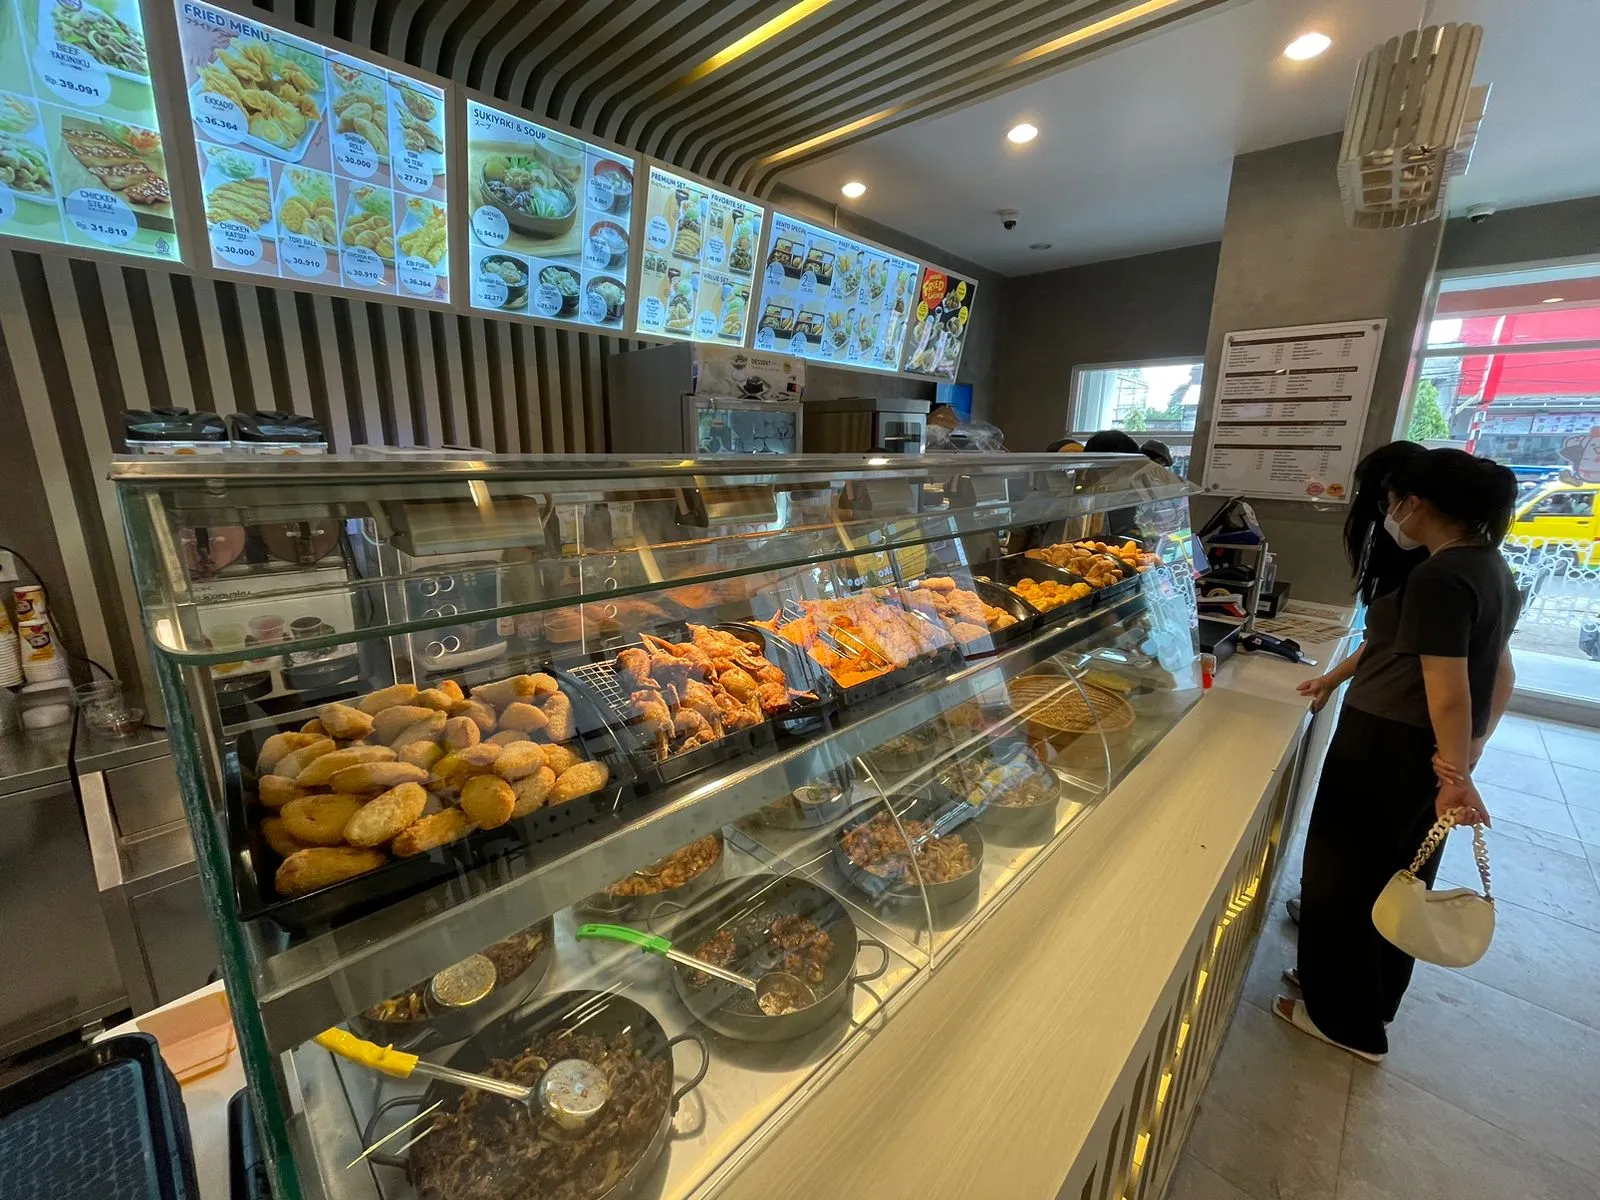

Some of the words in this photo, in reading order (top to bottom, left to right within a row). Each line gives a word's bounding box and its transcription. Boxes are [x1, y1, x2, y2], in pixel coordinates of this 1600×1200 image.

[183, 4, 226, 26] FRIED
[229, 19, 270, 42] MENU
[56, 42, 80, 56] BEEF
[59, 78, 100, 97] 39.091
[204, 116, 238, 131] 36.364
[474, 108, 514, 130] SUKIYAKI
[515, 123, 522, 133] &
[524, 126, 547, 140] SOUP
[344, 155, 371, 168] 30.000
[80, 190, 118, 204] CHICKEN
[87, 199, 114, 211] STEAK
[90, 223, 128, 237] 31.819
[220, 222, 250, 234] CHICKEN
[225, 230, 247, 240] KATSU
[303, 238, 318, 248] BALL
[224, 245, 255, 257] 30.000
[292, 257, 320, 268] 30.910
[353, 269, 378, 279] 30.910
[801, 273, 808, 287] 2
[409, 278, 431, 288] 36.364
[751, 358, 772, 367] DESSERT
